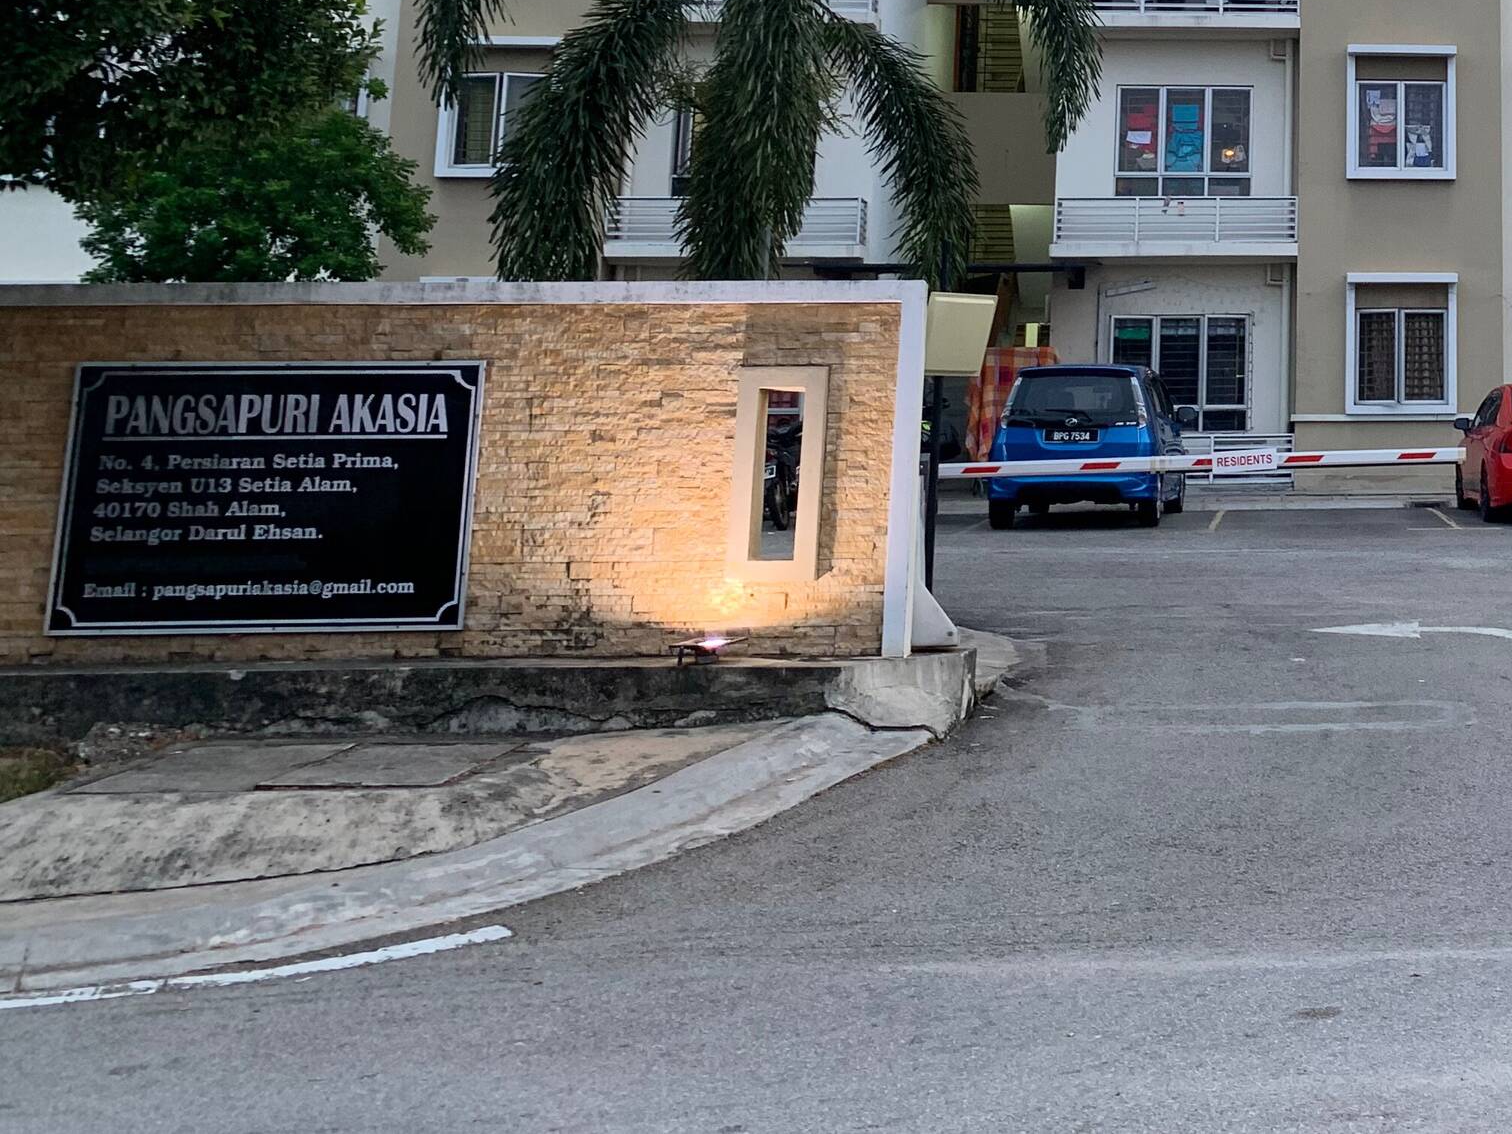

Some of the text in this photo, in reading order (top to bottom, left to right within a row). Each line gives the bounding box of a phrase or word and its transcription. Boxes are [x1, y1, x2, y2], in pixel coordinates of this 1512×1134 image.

[104, 393, 449, 435] PANGSAPURI AKASIA
[1070, 431, 1091, 441] 7534
[99, 455, 133, 470] No.
[167, 453, 266, 470] Persiaran
[272, 453, 326, 469] Setia
[332, 452, 399, 470] Prima,
[1216, 454, 1273, 467] RESIDENTS
[96, 476, 358, 497] Seksyen U13 Setia Alam,
[92, 500, 287, 518] 40170 Shah Alam,
[89, 523, 324, 546] Selangor Darul Ehsan.
[82, 582, 137, 598] Email
[152, 579, 415, 601] pangsapuriakasia@gmail.com
